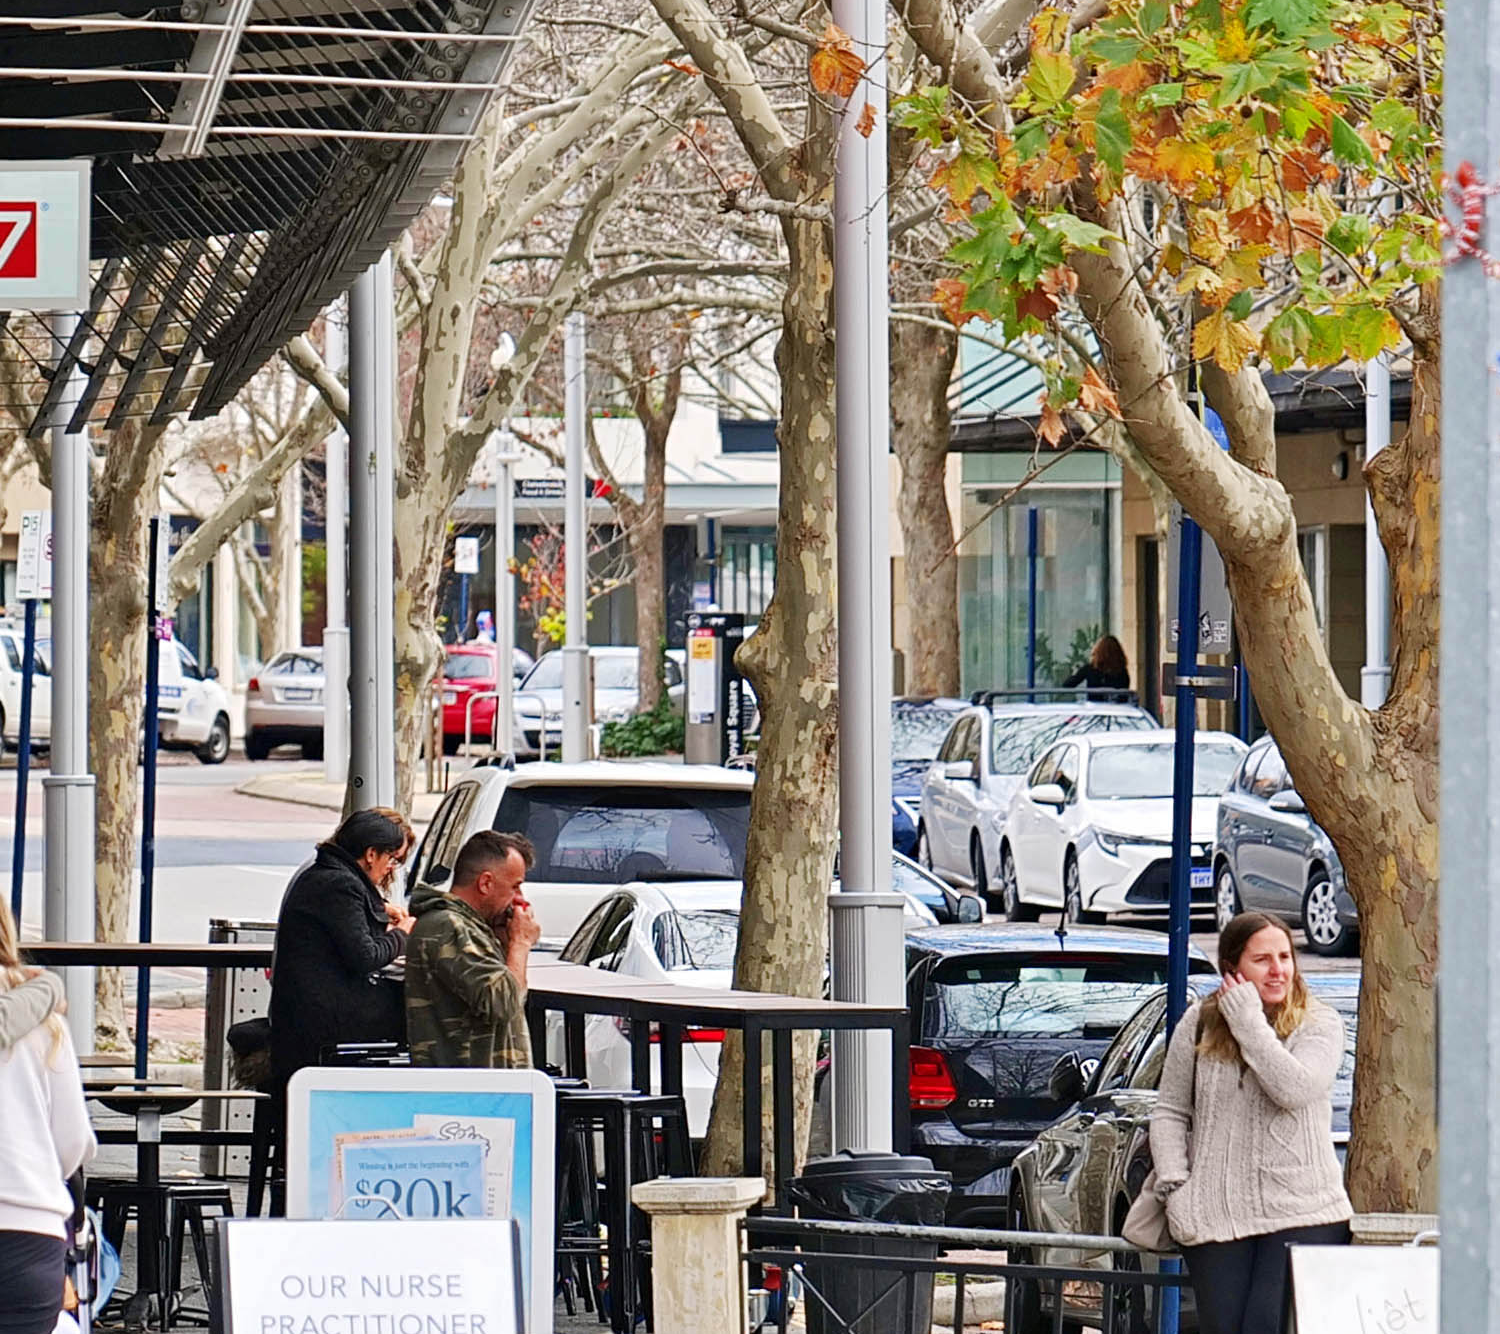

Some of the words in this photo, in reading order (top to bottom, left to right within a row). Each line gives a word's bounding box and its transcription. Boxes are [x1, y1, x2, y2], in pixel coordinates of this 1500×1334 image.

[968, 1099, 996, 1108] GTI
[454, 1161, 469, 1169] with
[281, 1275, 347, 1299] OUR
[361, 1274, 463, 1298] NURSE
